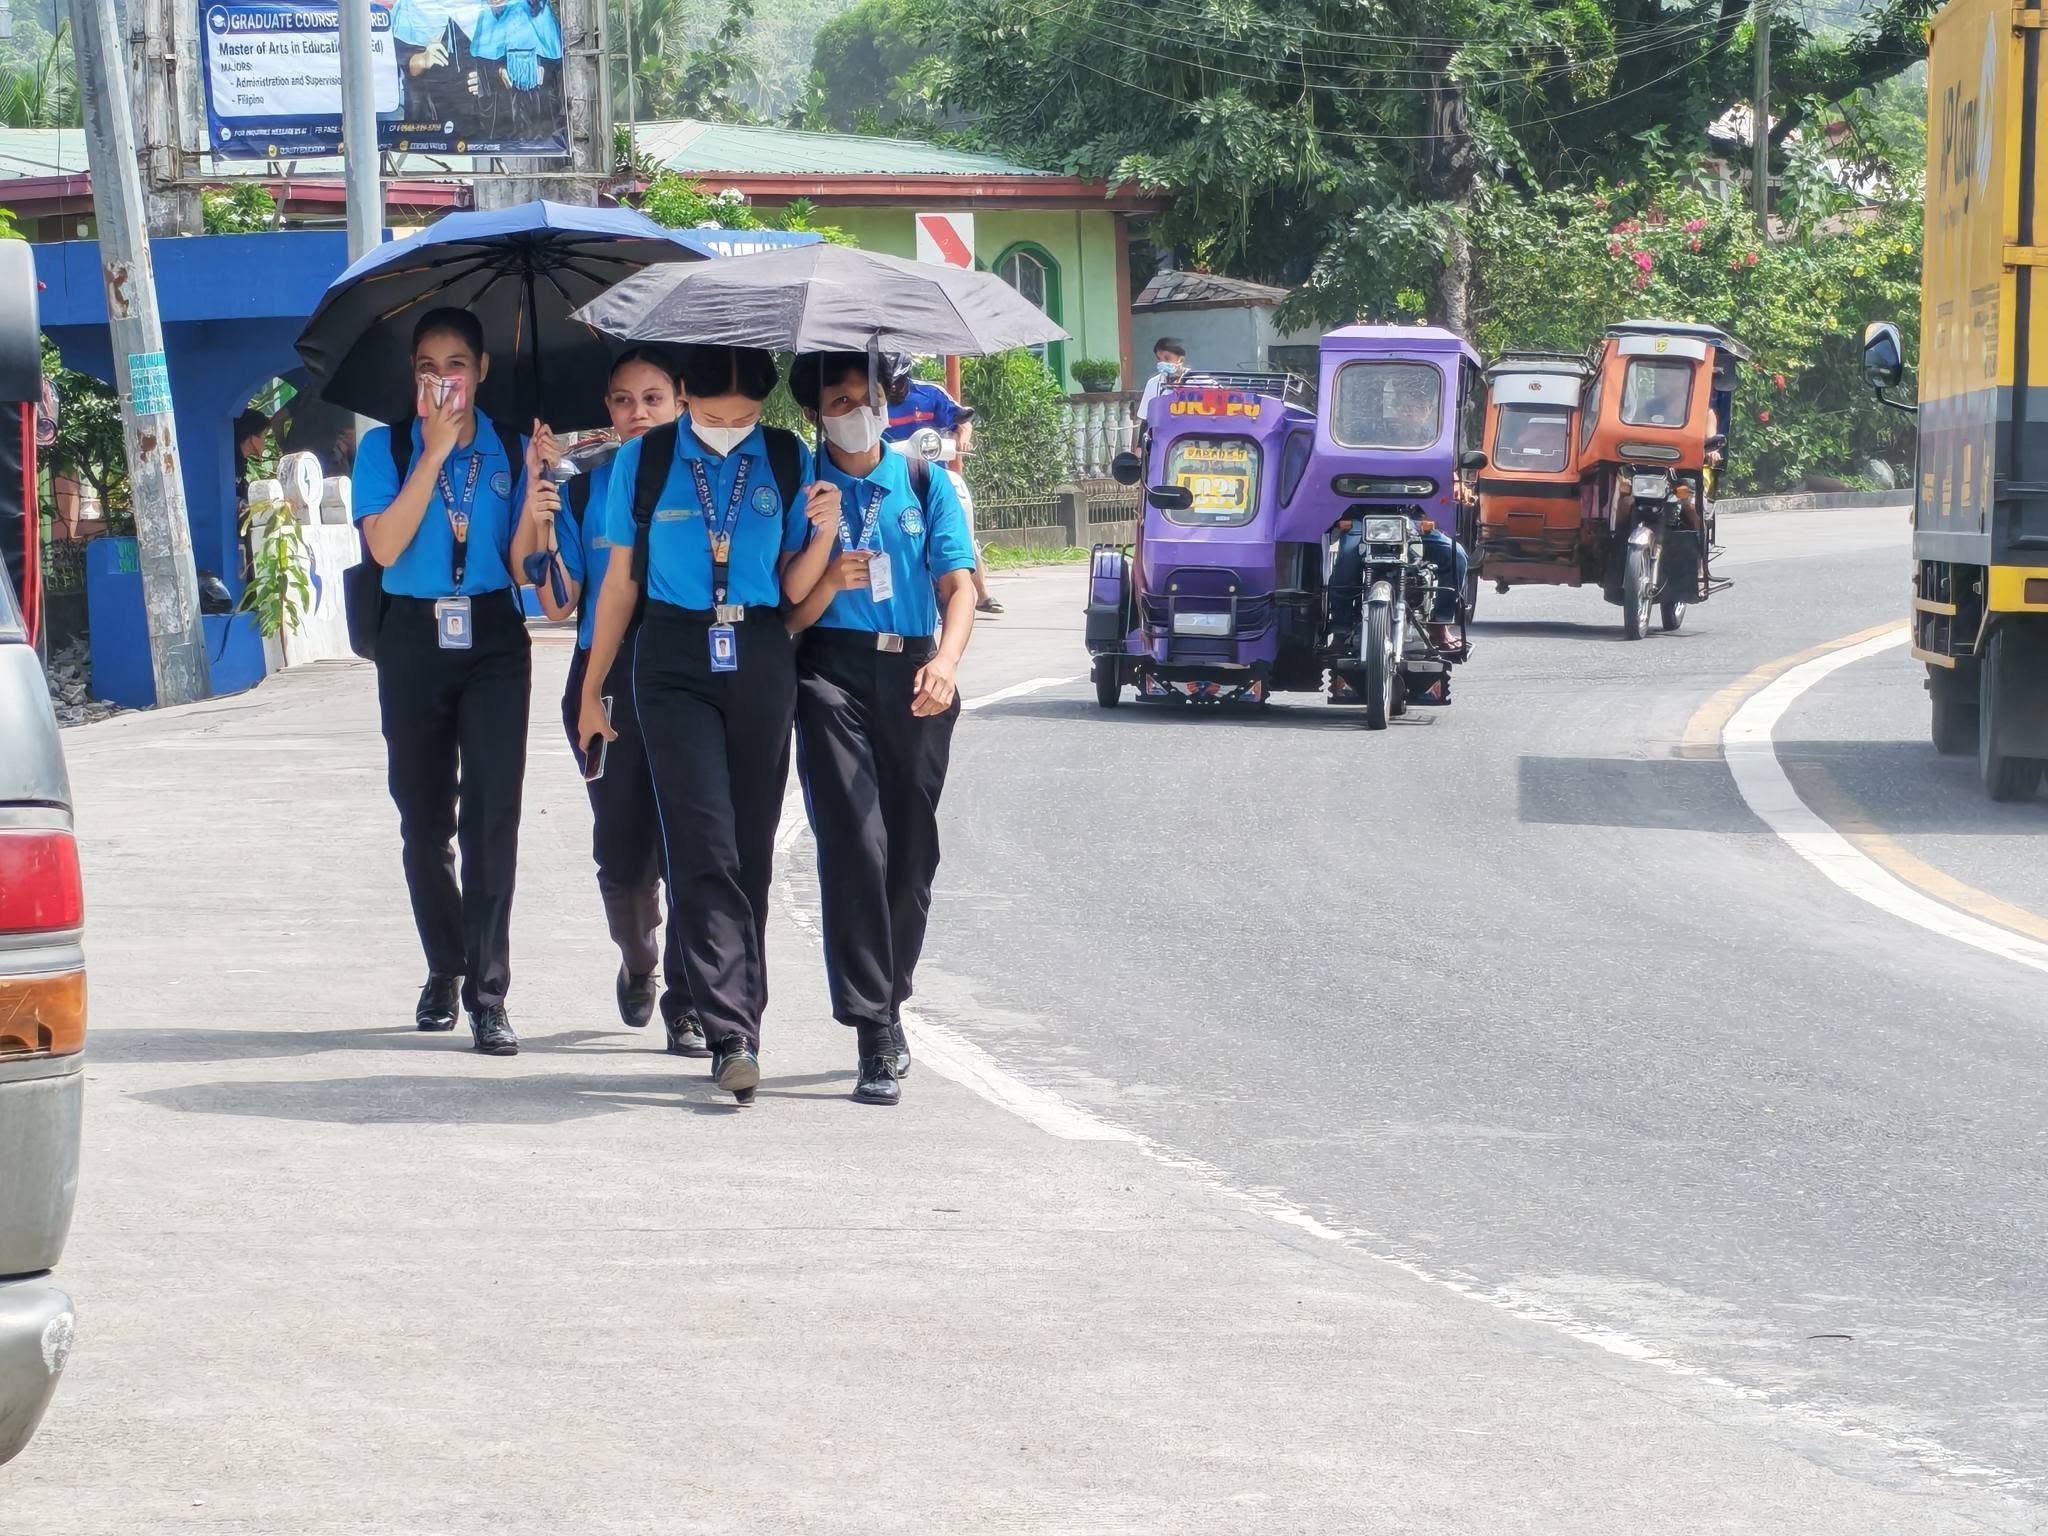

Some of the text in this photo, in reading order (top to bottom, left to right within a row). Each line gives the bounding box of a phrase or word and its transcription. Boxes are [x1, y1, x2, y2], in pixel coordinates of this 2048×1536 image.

[231, 13, 293, 30] GRADUATE
[295, 12, 340, 28] COURSE
[219, 41, 254, 56] Master
[256, 40, 266, 54] of
[268, 40, 289, 54] Arts
[291, 40, 301, 54] in
[303, 40, 341, 53] Educati
[220, 62, 253, 72] MAJORS:
[236, 74, 342, 88] Administration and Supervisio
[237, 94, 264, 107] Filipino
[726, 459, 749, 521] PLT COLLEGE
[700, 478, 717, 521] COLLEGE
